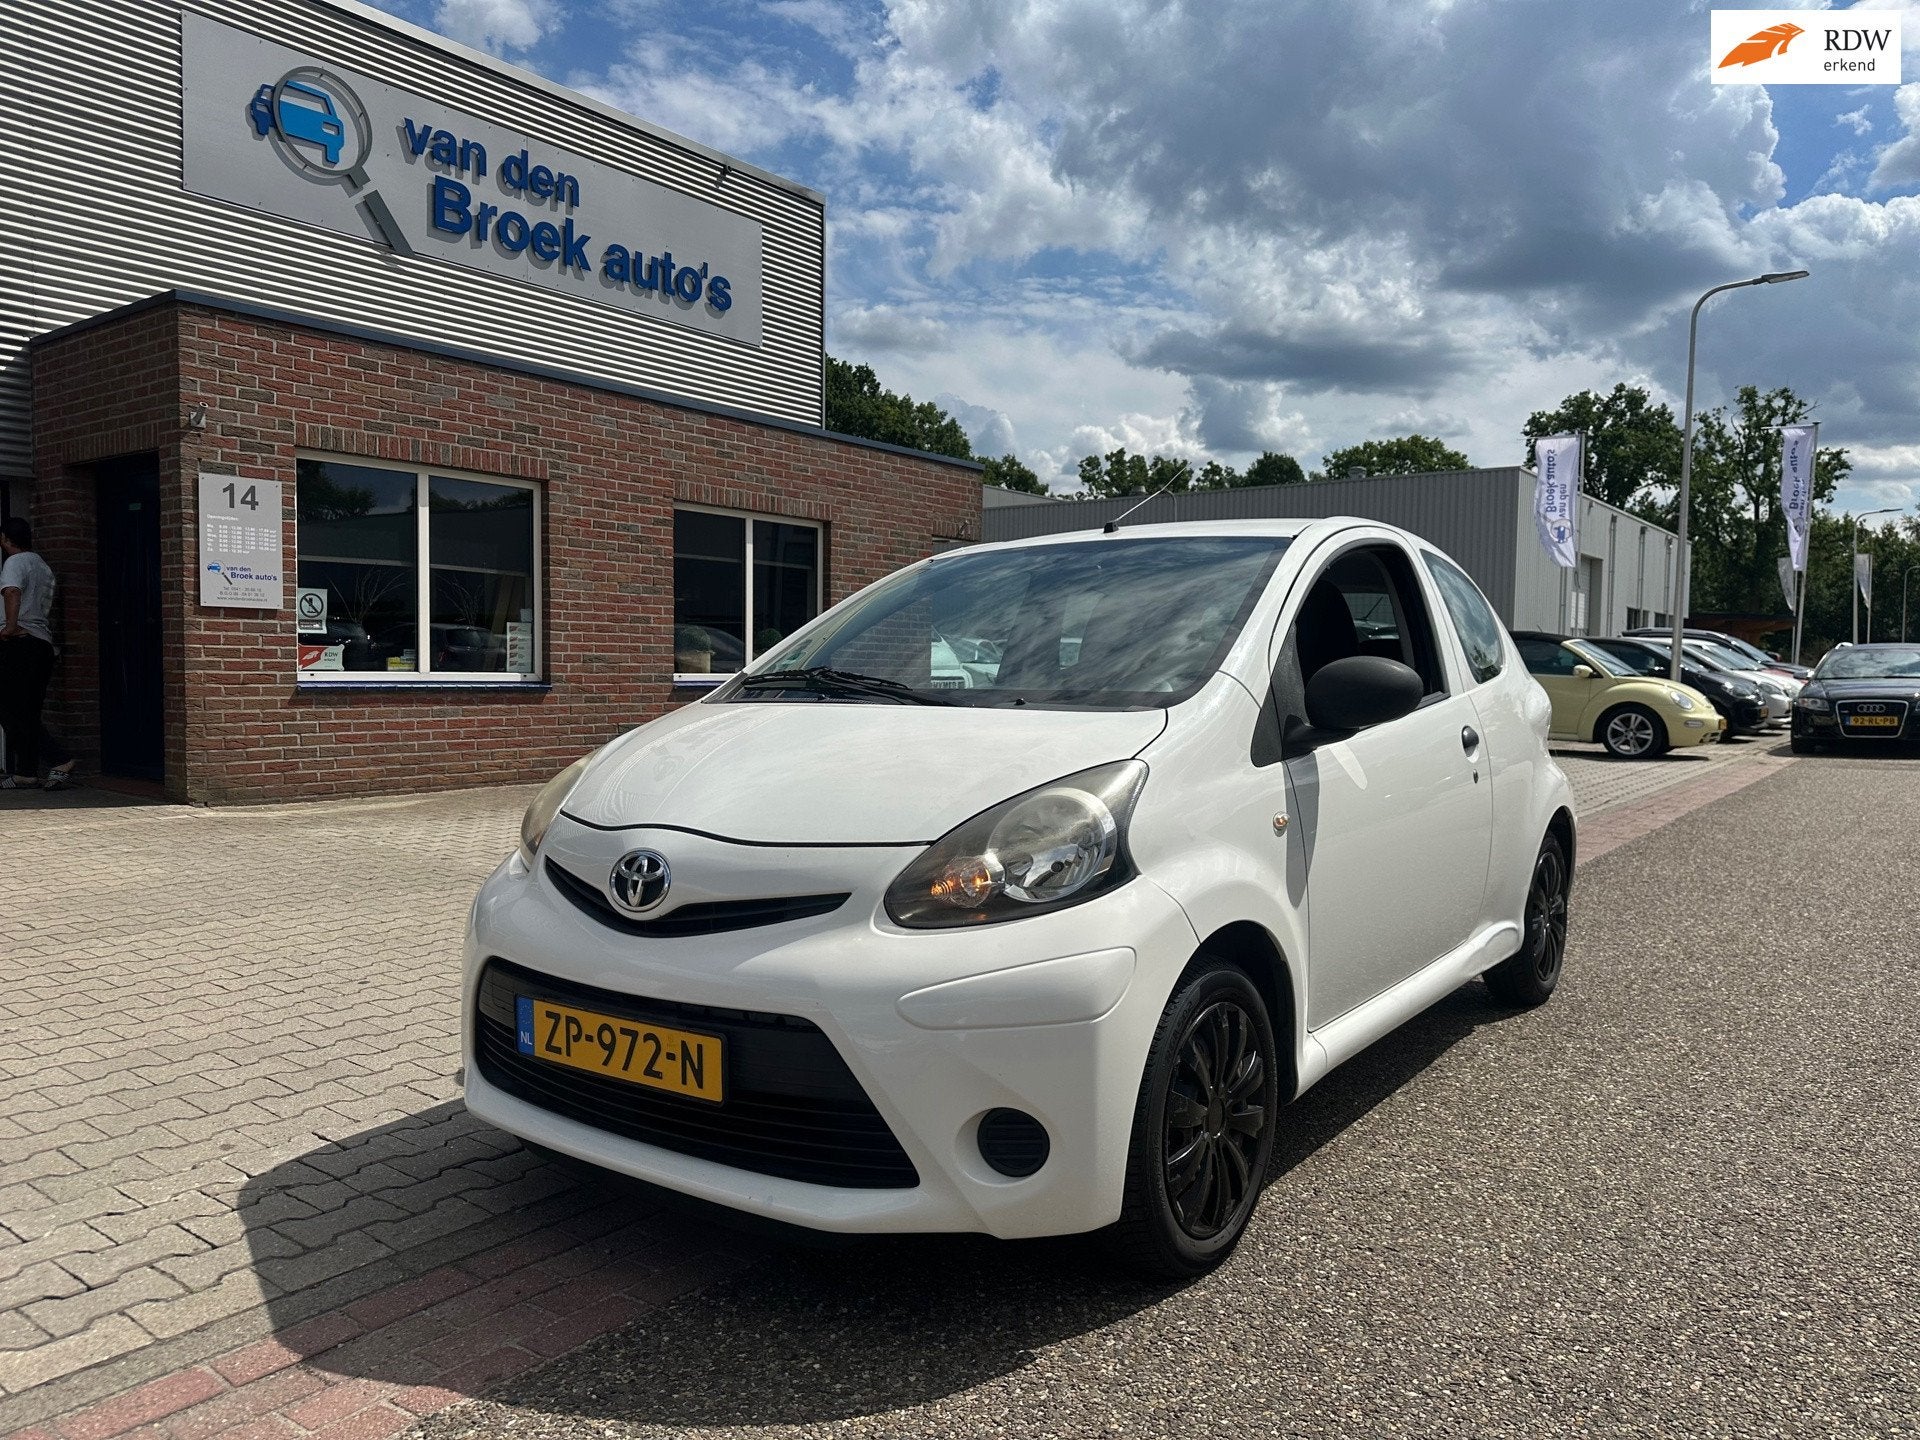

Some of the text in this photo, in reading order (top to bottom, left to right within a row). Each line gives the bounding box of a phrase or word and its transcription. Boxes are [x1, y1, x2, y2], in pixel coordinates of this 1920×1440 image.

[403, 117, 580, 208] van den
[434, 175, 733, 312] Broek auto's
[222, 482, 259, 511] 14
[230, 572, 254, 580] Broek
[520, 1030, 533, 1046] NL
[545, 1010, 704, 1090] ZP-972-N
